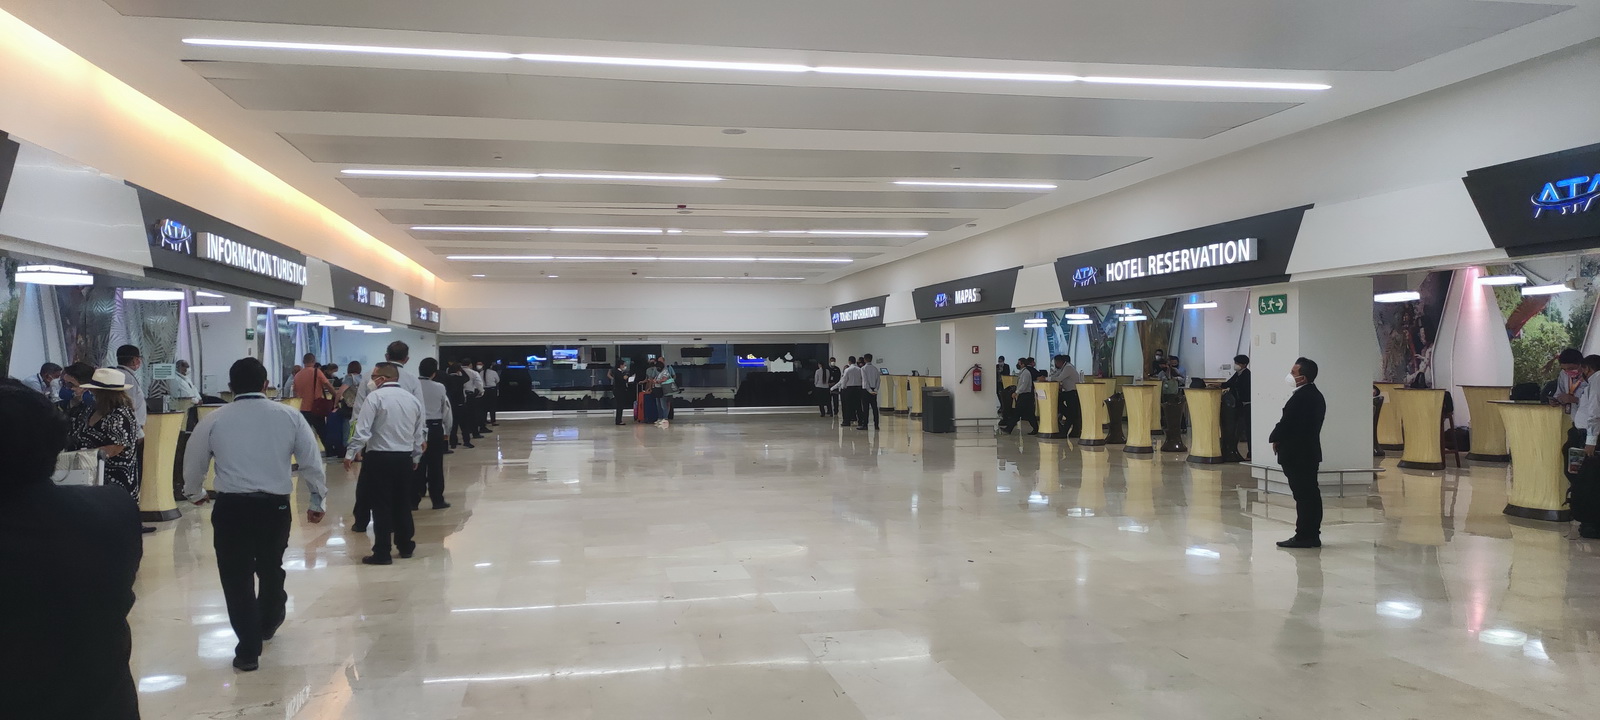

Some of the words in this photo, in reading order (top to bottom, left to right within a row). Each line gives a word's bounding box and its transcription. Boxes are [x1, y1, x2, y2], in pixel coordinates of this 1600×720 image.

[206, 232, 271, 276] INFORMACION
[272, 256, 308, 286] TURISTICA
[1106, 258, 1145, 283] HOTEL
[1149, 238, 1251, 276] RESERVATION
[955, 288, 977, 304] MAPAS
